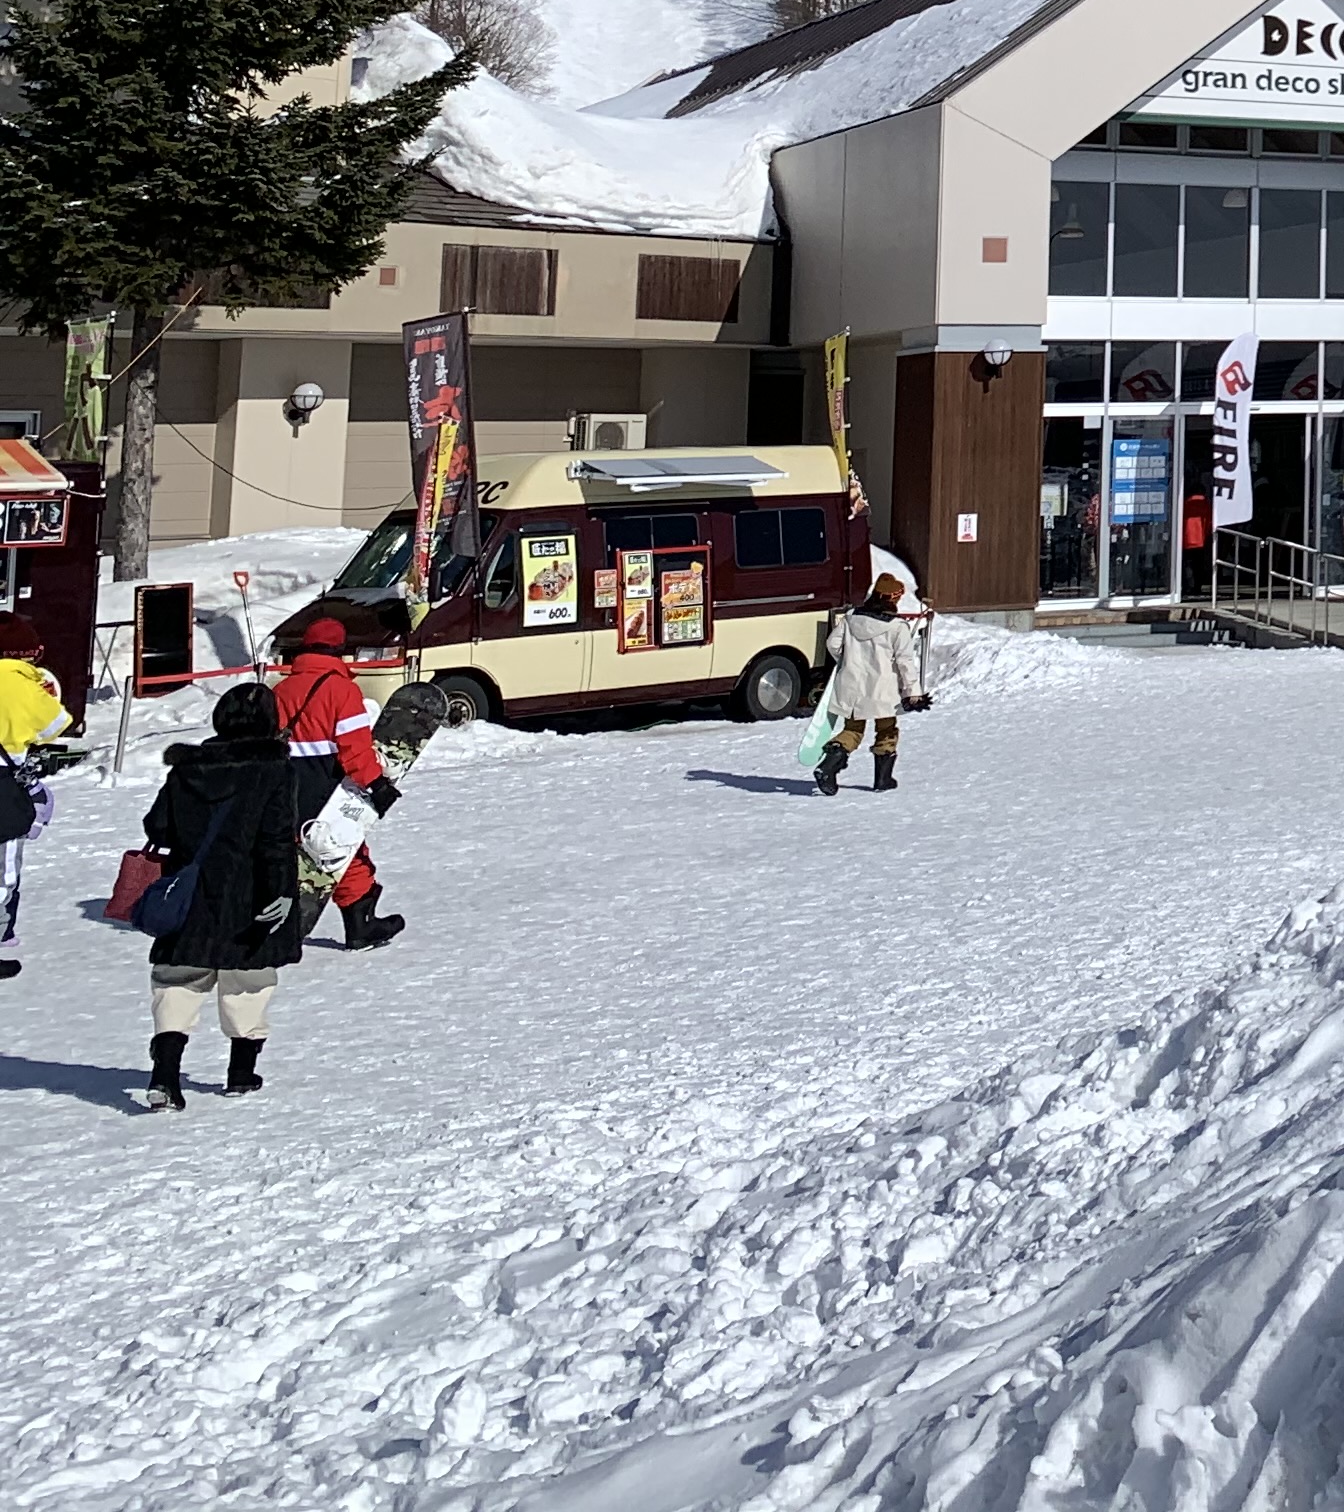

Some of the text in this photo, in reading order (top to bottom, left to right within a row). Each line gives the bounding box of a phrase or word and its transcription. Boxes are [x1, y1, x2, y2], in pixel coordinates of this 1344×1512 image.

[1181, 68, 1248, 93] gran
[1255, 69, 1321, 94] deco
[1213, 397, 1238, 500] FIRE
[679, 593, 695, 602] 400
